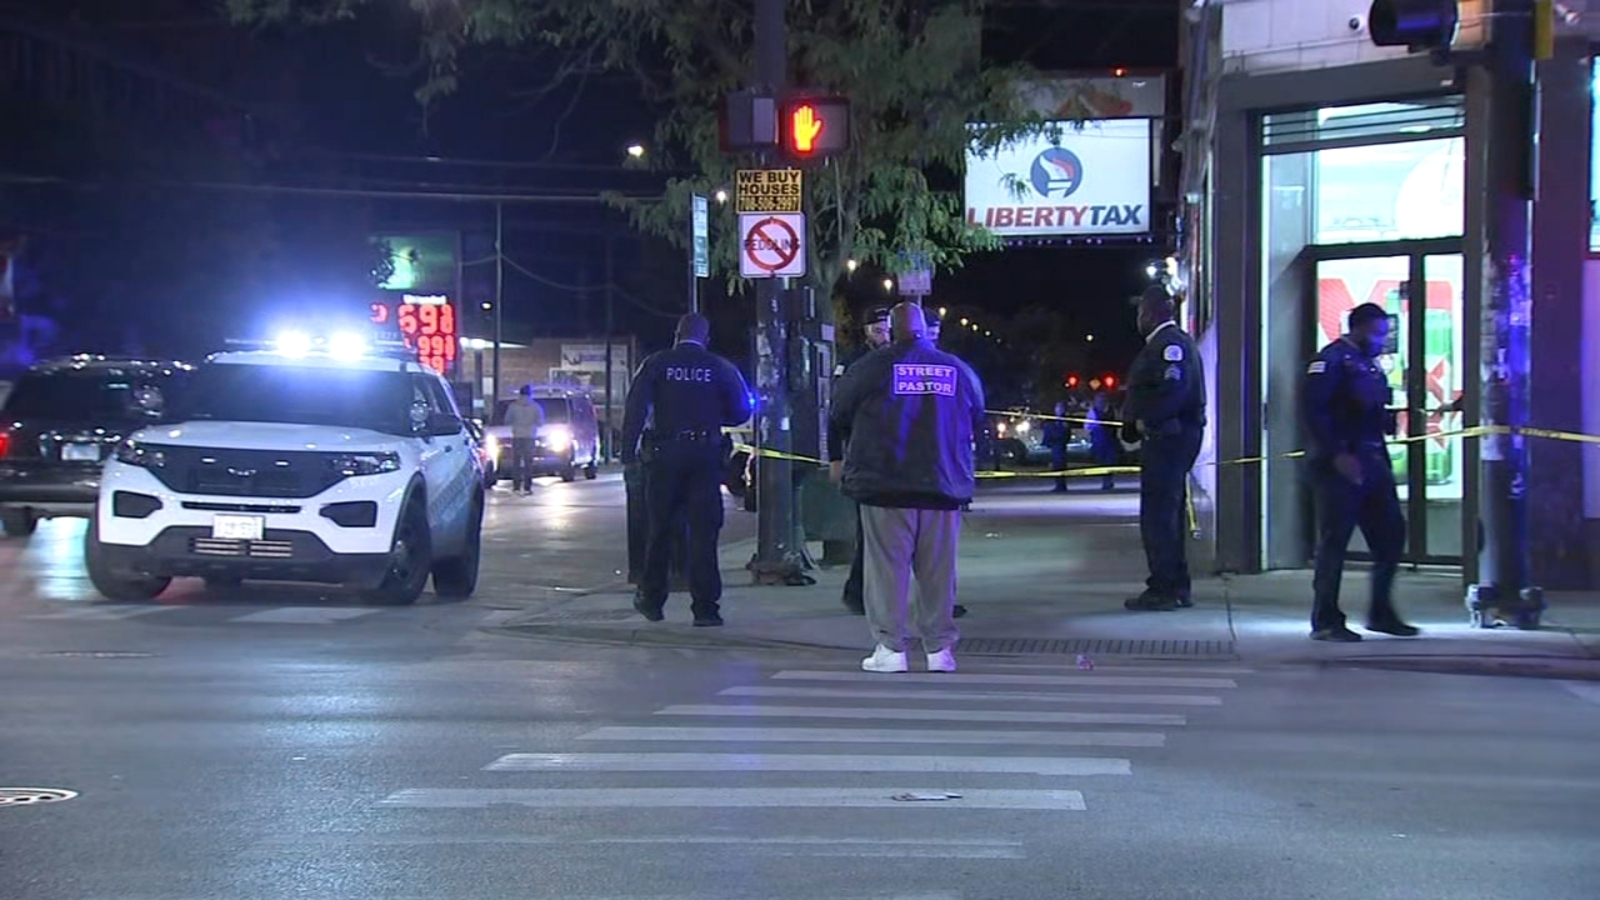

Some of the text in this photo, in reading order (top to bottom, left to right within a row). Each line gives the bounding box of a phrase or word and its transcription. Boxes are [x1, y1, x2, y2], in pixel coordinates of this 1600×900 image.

[739, 171, 799, 183] WE BUY
[739, 183, 800, 195] HOUSES
[666, 367, 712, 382] POLICE
[898, 367, 952, 378] STREET
[899, 381, 952, 393] PASTOR
